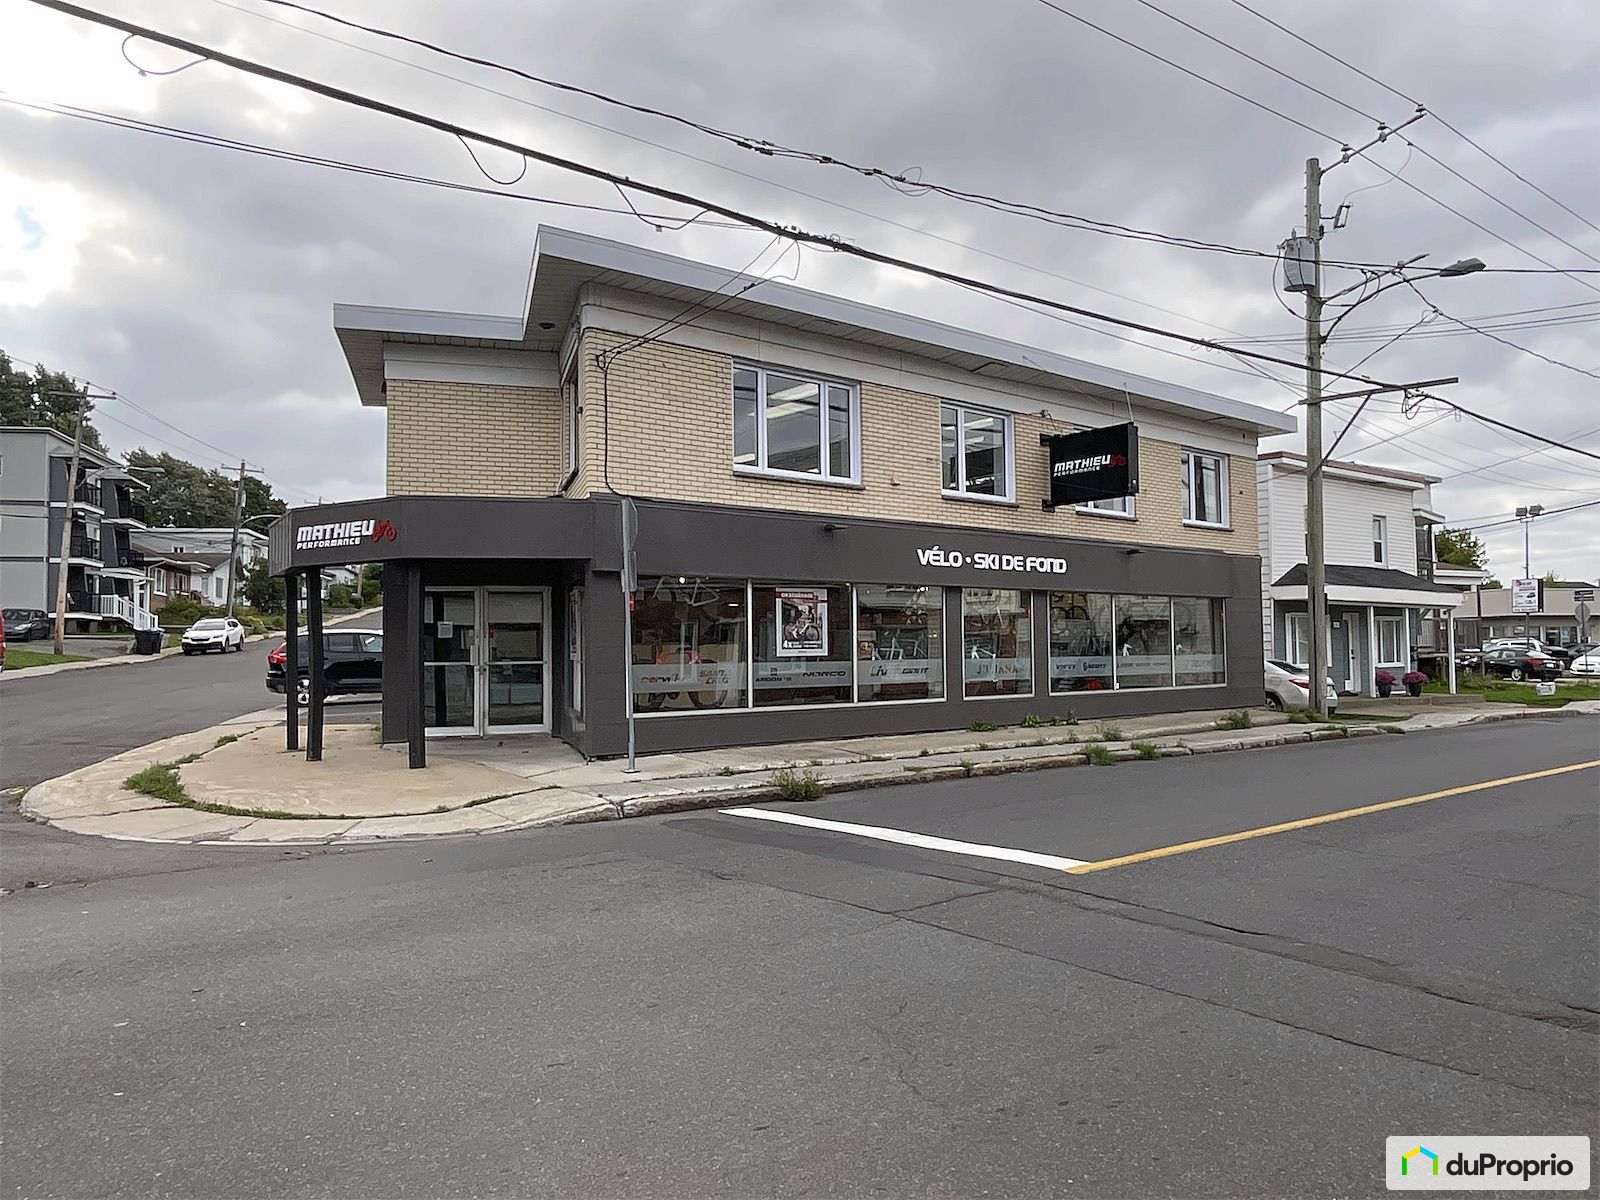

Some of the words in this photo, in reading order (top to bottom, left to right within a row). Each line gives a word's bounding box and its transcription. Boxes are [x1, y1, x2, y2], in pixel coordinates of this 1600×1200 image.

[1053, 465, 1101, 477] PERFORMANCE
[1054, 454, 1111, 473] MATHIEU
[297, 519, 376, 542] MATHIEU
[296, 537, 362, 550] PERFORMANCE
[916, 545, 963, 567] VÉLO
[973, 552, 1000, 570] SKI
[1001, 554, 1024, 571] DE
[1025, 556, 1067, 574] FOND
[976, 662, 1019, 675] JUIANA
